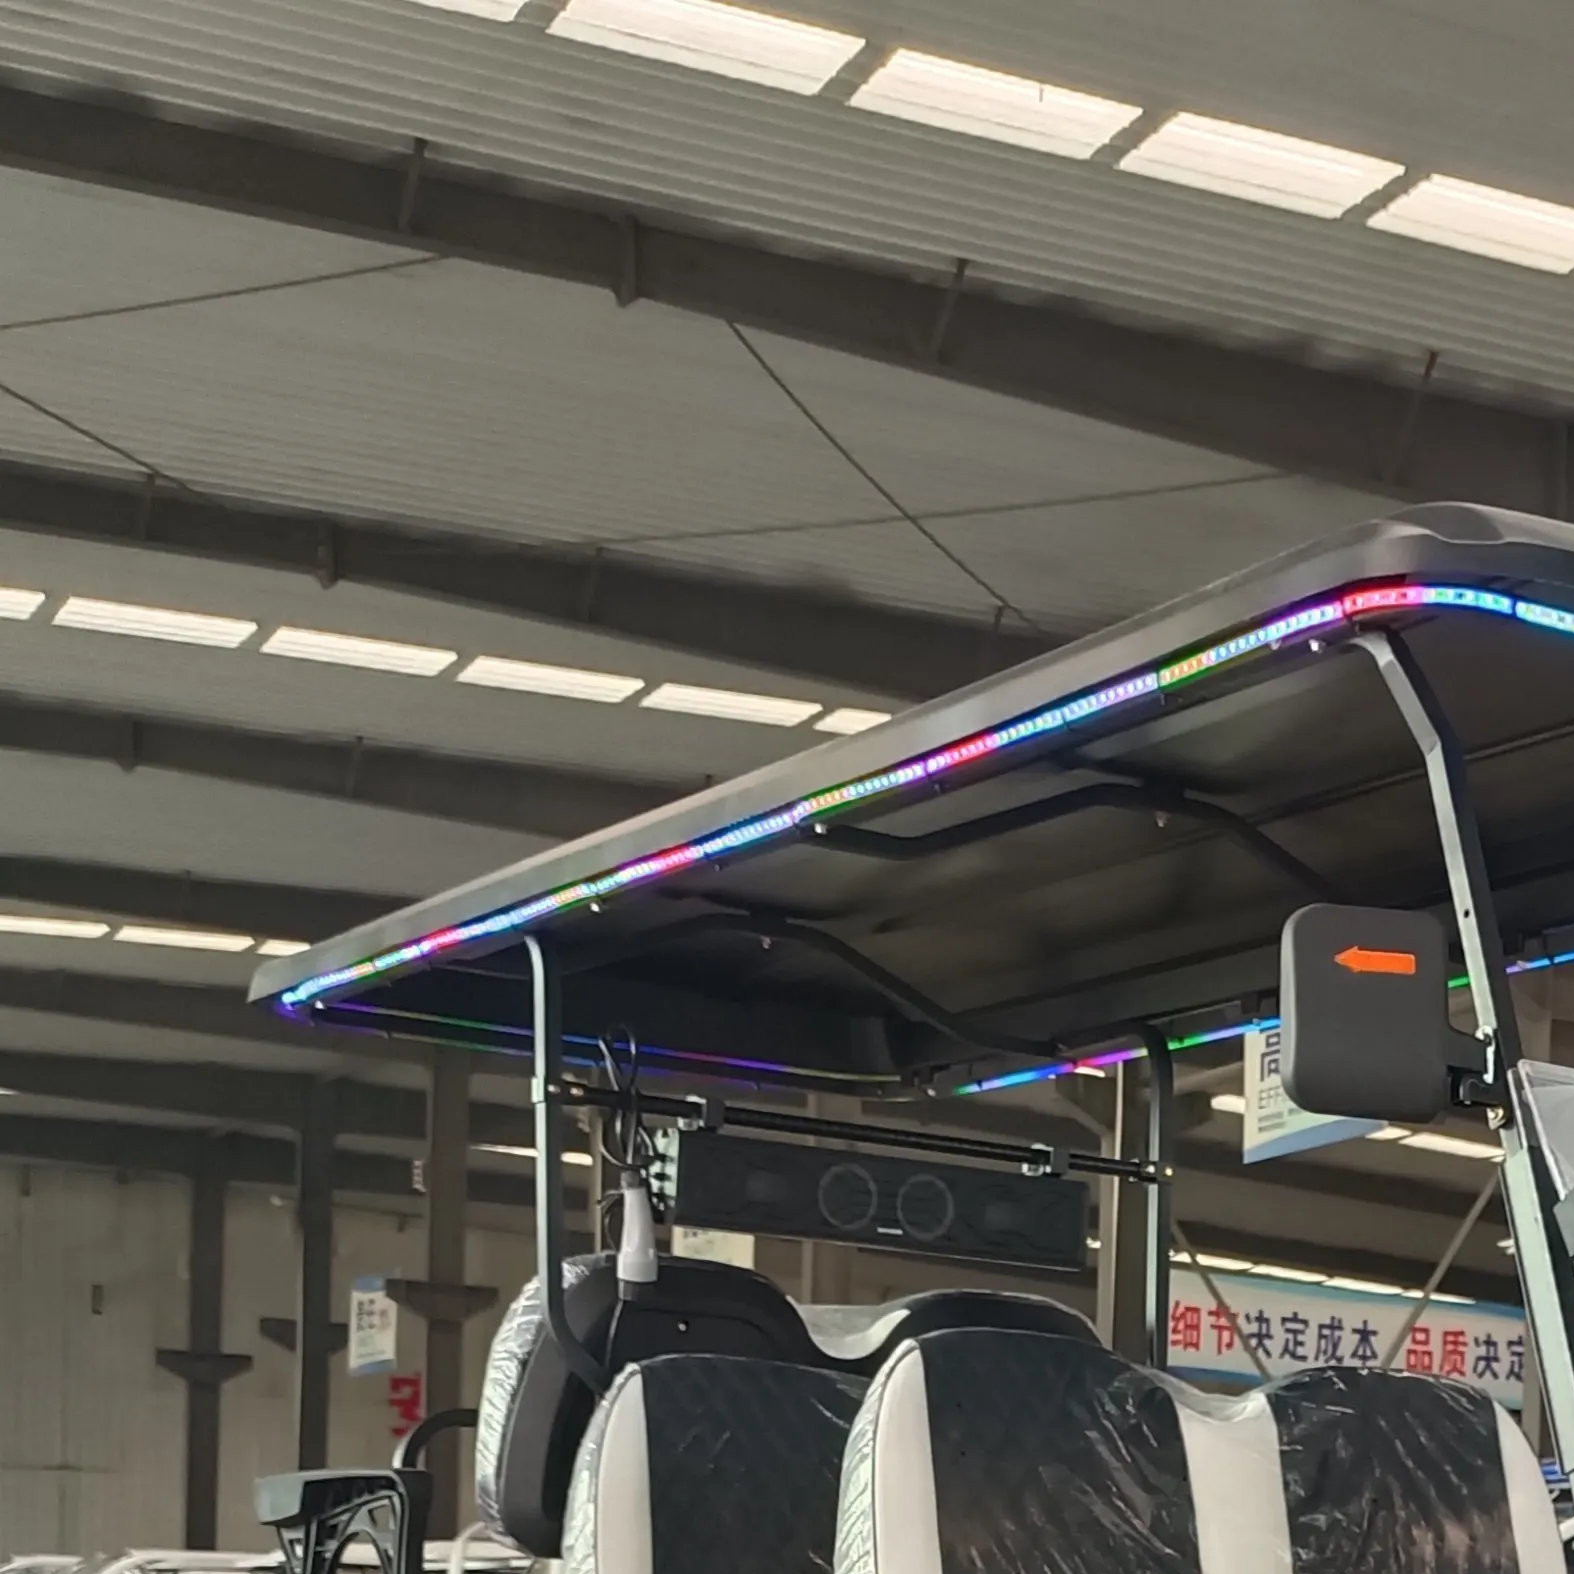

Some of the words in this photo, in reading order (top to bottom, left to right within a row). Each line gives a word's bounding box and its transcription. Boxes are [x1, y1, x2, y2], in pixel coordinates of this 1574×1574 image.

[1170, 1301, 1379, 1366] 细节决定成本
